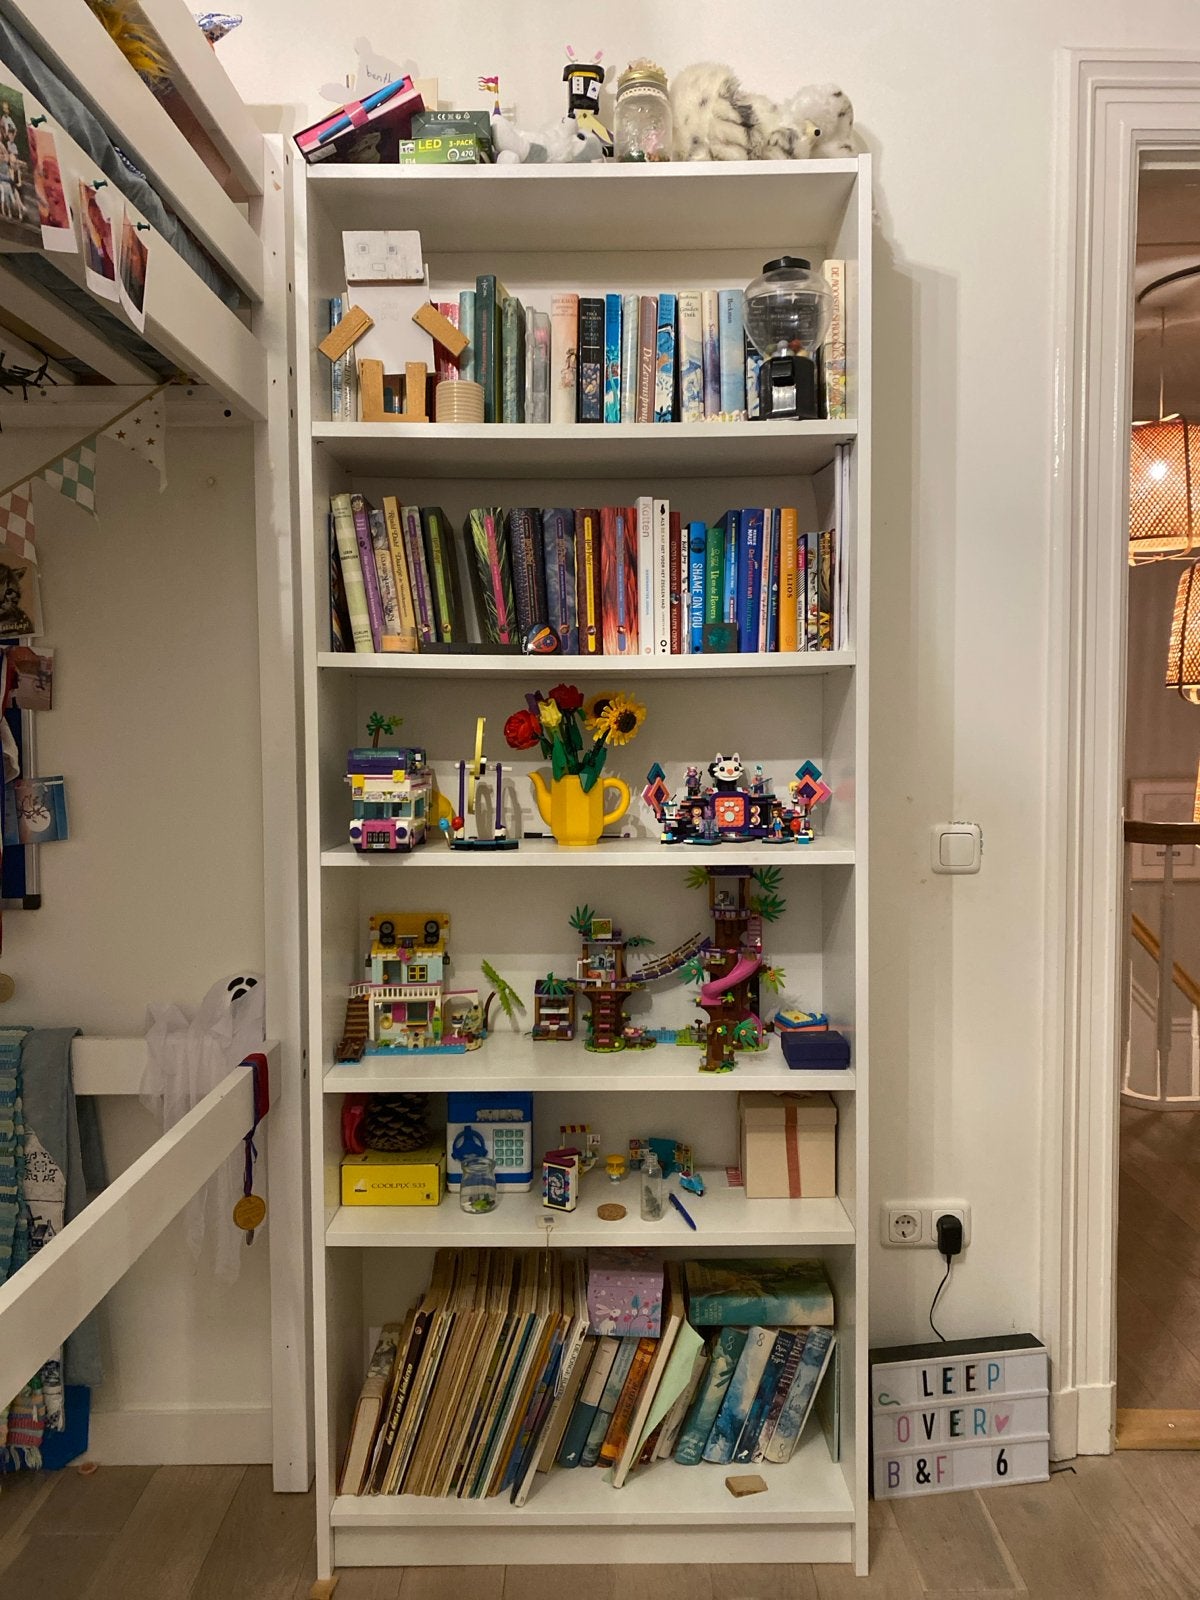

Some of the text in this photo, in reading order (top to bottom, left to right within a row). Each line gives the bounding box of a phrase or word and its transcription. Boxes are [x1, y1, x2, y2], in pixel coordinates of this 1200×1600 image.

[418, 139, 442, 150] LED
[448, 139, 474, 148] 3-PACK
[831, 267, 839, 277] DE
[643, 347, 652, 363] De
[388, 510, 397, 530] Roald
[642, 503, 650, 537] Katten
[391, 530, 399, 547] Dahl
[749, 549, 755, 558] De
[692, 563, 702, 628] SHAME ON YOU
[710, 595, 719, 619] Rovers
[922, 1363, 1000, 1397] LEEP
[897, 1408, 987, 1443] OVER
[996, 1449, 1008, 1476] 6
